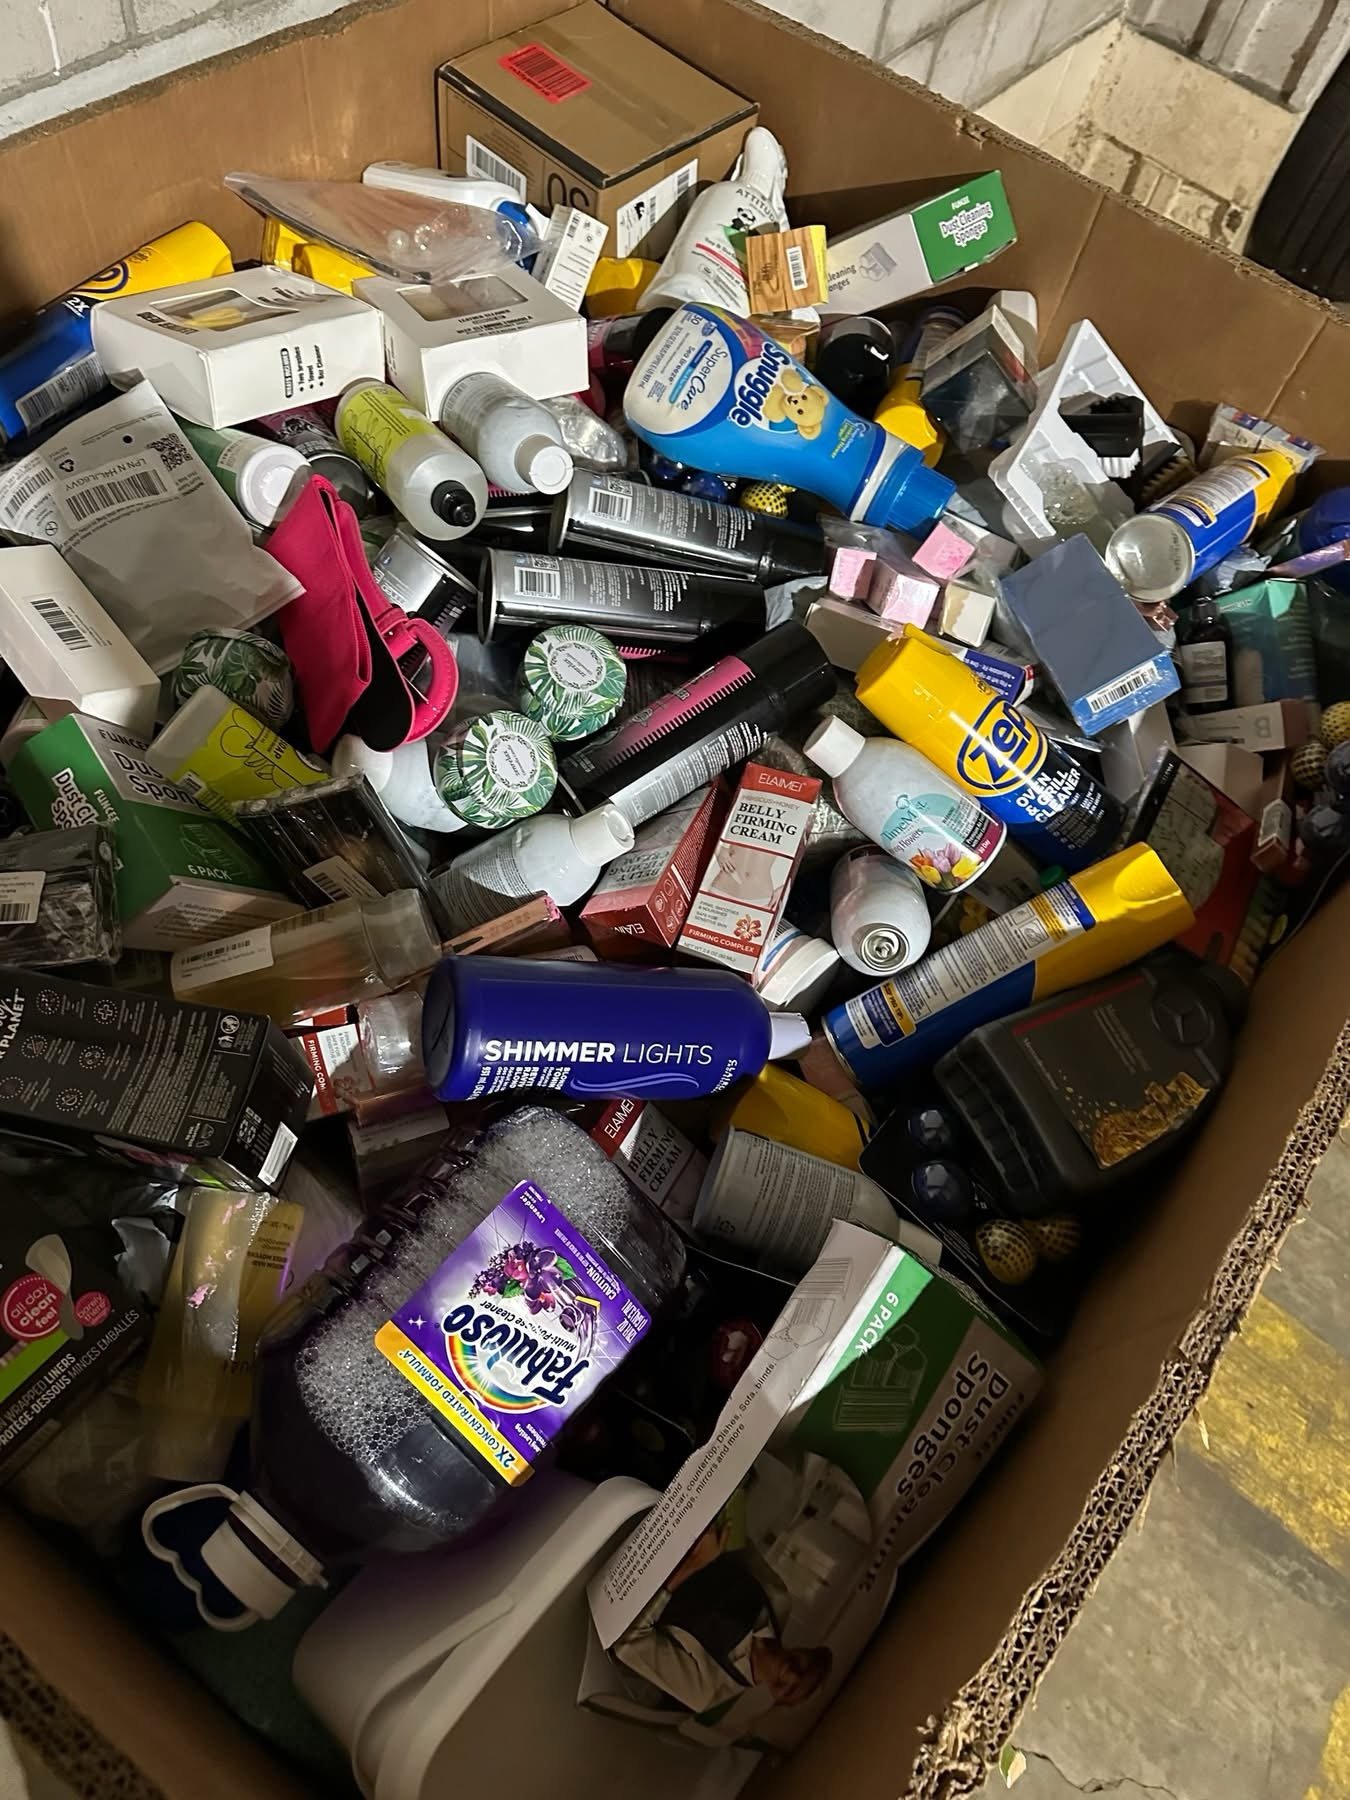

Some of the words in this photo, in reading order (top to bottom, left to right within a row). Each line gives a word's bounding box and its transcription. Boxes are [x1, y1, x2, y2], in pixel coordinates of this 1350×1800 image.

[735, 187, 781, 224] ATTITUD
[941, 220, 958, 235] Dust
[959, 203, 992, 225] Cleaning
[955, 220, 987, 244] Sponges
[313, 345, 322, 367] Cleaner
[731, 342, 791, 427] Snuggle
[126, 456, 146, 470] LPN
[98, 728, 149, 751] FUNCE
[113, 749, 164, 779] Dus
[54, 770, 83, 808] Dust
[758, 773, 804, 793] ELAIMEI
[1016, 772, 1052, 809] OVEN
[1035, 767, 1082, 824] CLEANER
[1037, 770, 1070, 806] GRILL
[734, 813, 798, 836] FIRMING
[739, 802, 786, 820] BELLY
[730, 825, 783, 845] CREAM
[187, 864, 197, 876] 6
[196, 865, 233, 882] PACK
[687, 928, 719, 943] FIRMING
[719, 937, 755, 953] COMPLEX
[2, 993, 26, 1049] PLANET
[307, 1039, 322, 1071] FIRMING
[483, 1040, 616, 1063] SHIMMER
[622, 1043, 714, 1065] LIGHTS
[602, 1097, 635, 1138] ELAIMEI
[626, 1126, 659, 1172] BELLY
[636, 1126, 676, 1183] FIRMING
[646, 1143, 682, 1193] CREAM
[518, 1193, 546, 1223] Lavender
[584, 1263, 617, 1301] CAUTION:
[886, 1292, 899, 1306] 6
[11, 1302, 23, 1319] all
[26, 1283, 48, 1308] day
[19, 1292, 57, 1327] clean
[35, 1307, 58, 1328] feel
[77, 1293, 104, 1319] barely
[84, 1301, 107, 1322] there
[479, 1298, 516, 1323] Cleaner
[67, 1347, 101, 1379] MINCES
[95, 1309, 140, 1352] EMBALLÉS
[853, 1304, 893, 1353] PACK
[444, 1305, 592, 1406] Fabuloso
[4, 1381, 49, 1421] WRAPPED
[44, 1352, 76, 1385] LINERS
[439, 1388, 501, 1451] CONCENTRATED
[898, 1353, 989, 1496] Sponges
[955, 1371, 1010, 1448] Dust
[512, 1422, 533, 1445] Lasting
[493, 1444, 517, 1468] 2X
[612, 1558, 642, 1595] Glasses
[636, 1547, 648, 1560] of
[642, 1515, 671, 1550] window
[666, 1506, 678, 1518] or
[673, 1490, 689, 1508] car,
[682, 1442, 723, 1492] countertop,
[714, 1410, 743, 1444] Dishes,
[737, 1387, 759, 1412] Sofa,
[617, 1574, 641, 1602] vents,
[634, 1525, 675, 1576] baseboard,
[669, 1492, 699, 1529] railings,
[692, 1461, 719, 1494] mirrors
[713, 1444, 731, 1463] and
[725, 1421, 747, 1446] more
[857, 1448, 957, 1592] Cleaning
[608, 1549, 641, 1588] U-Shape
[633, 1531, 650, 1550] and
[645, 1510, 666, 1534] easy
[659, 1501, 671, 1512] to
[665, 1481, 684, 1503] hold
